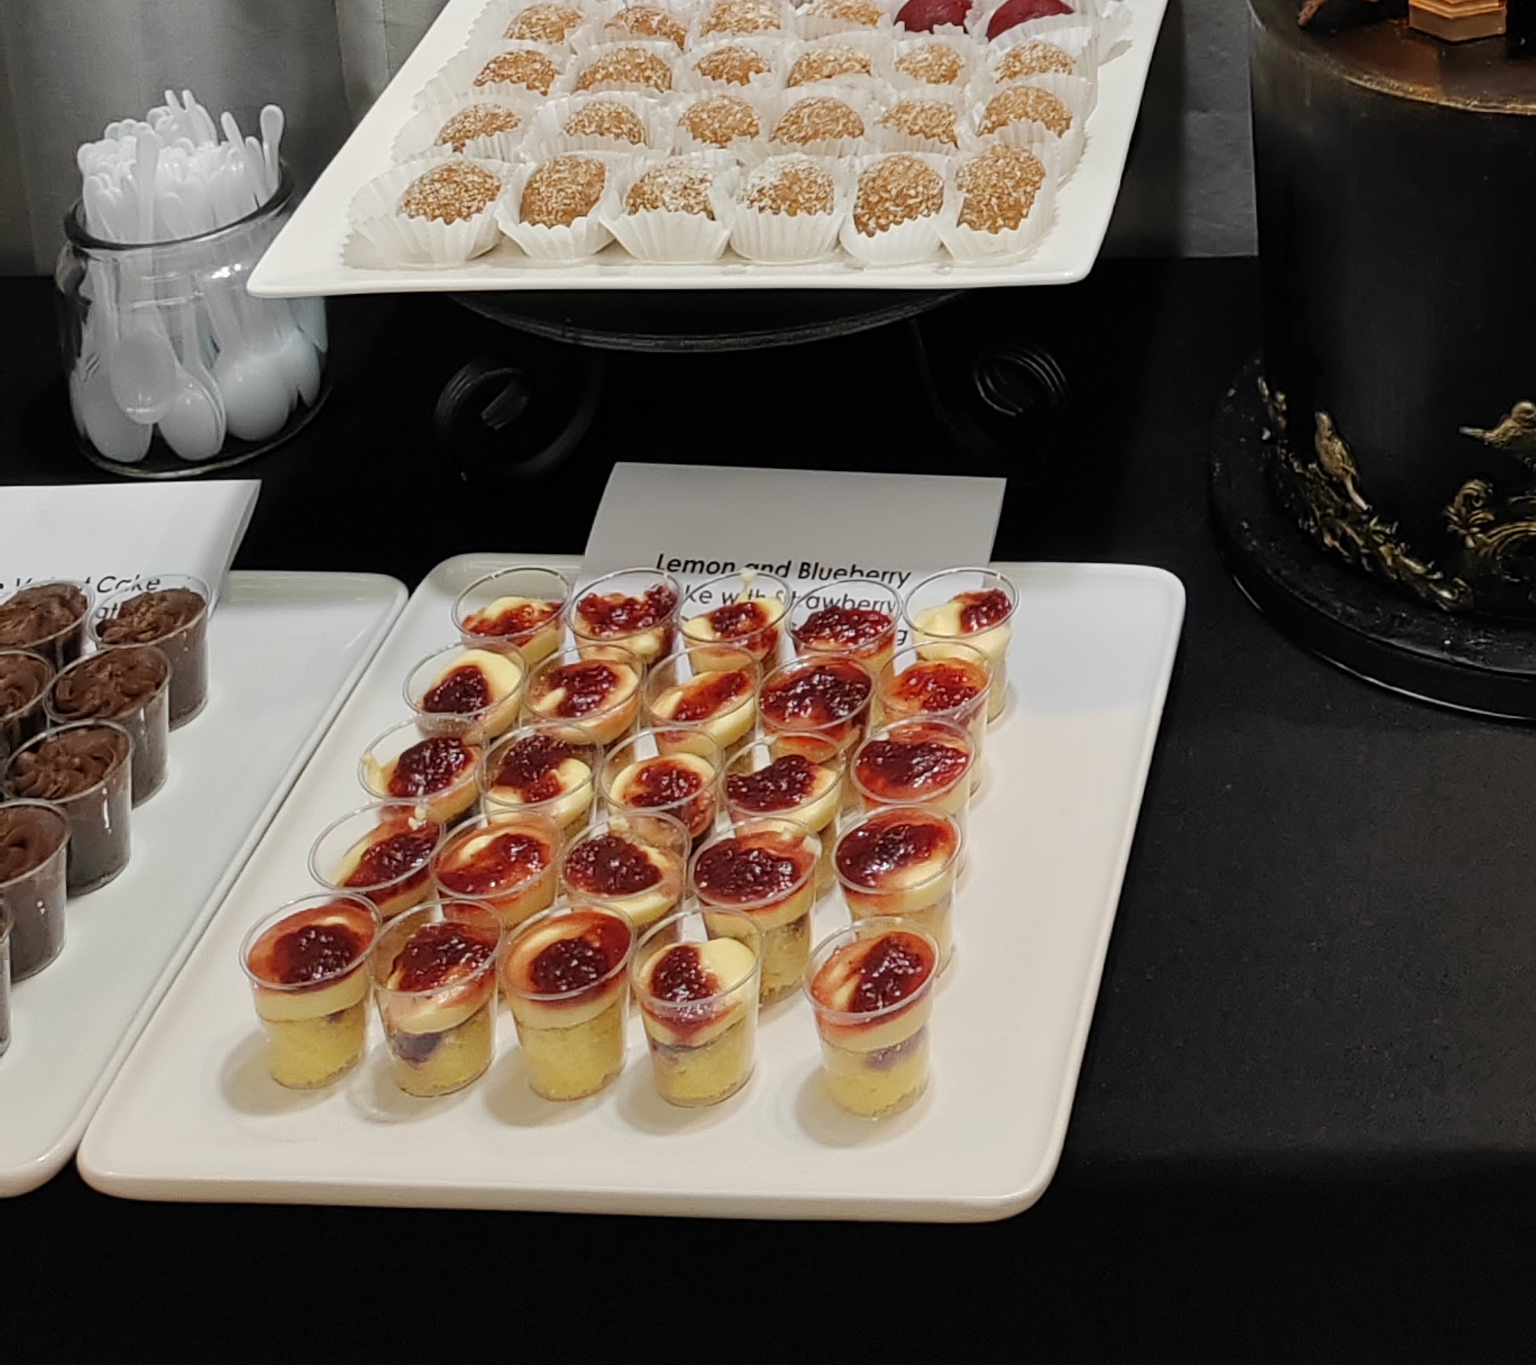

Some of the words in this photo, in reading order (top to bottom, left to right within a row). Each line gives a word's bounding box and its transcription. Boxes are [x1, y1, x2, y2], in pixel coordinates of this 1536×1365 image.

[655, 553, 736, 576] Lemon
[745, 559, 792, 579] and
[797, 561, 912, 590] Blueberry
